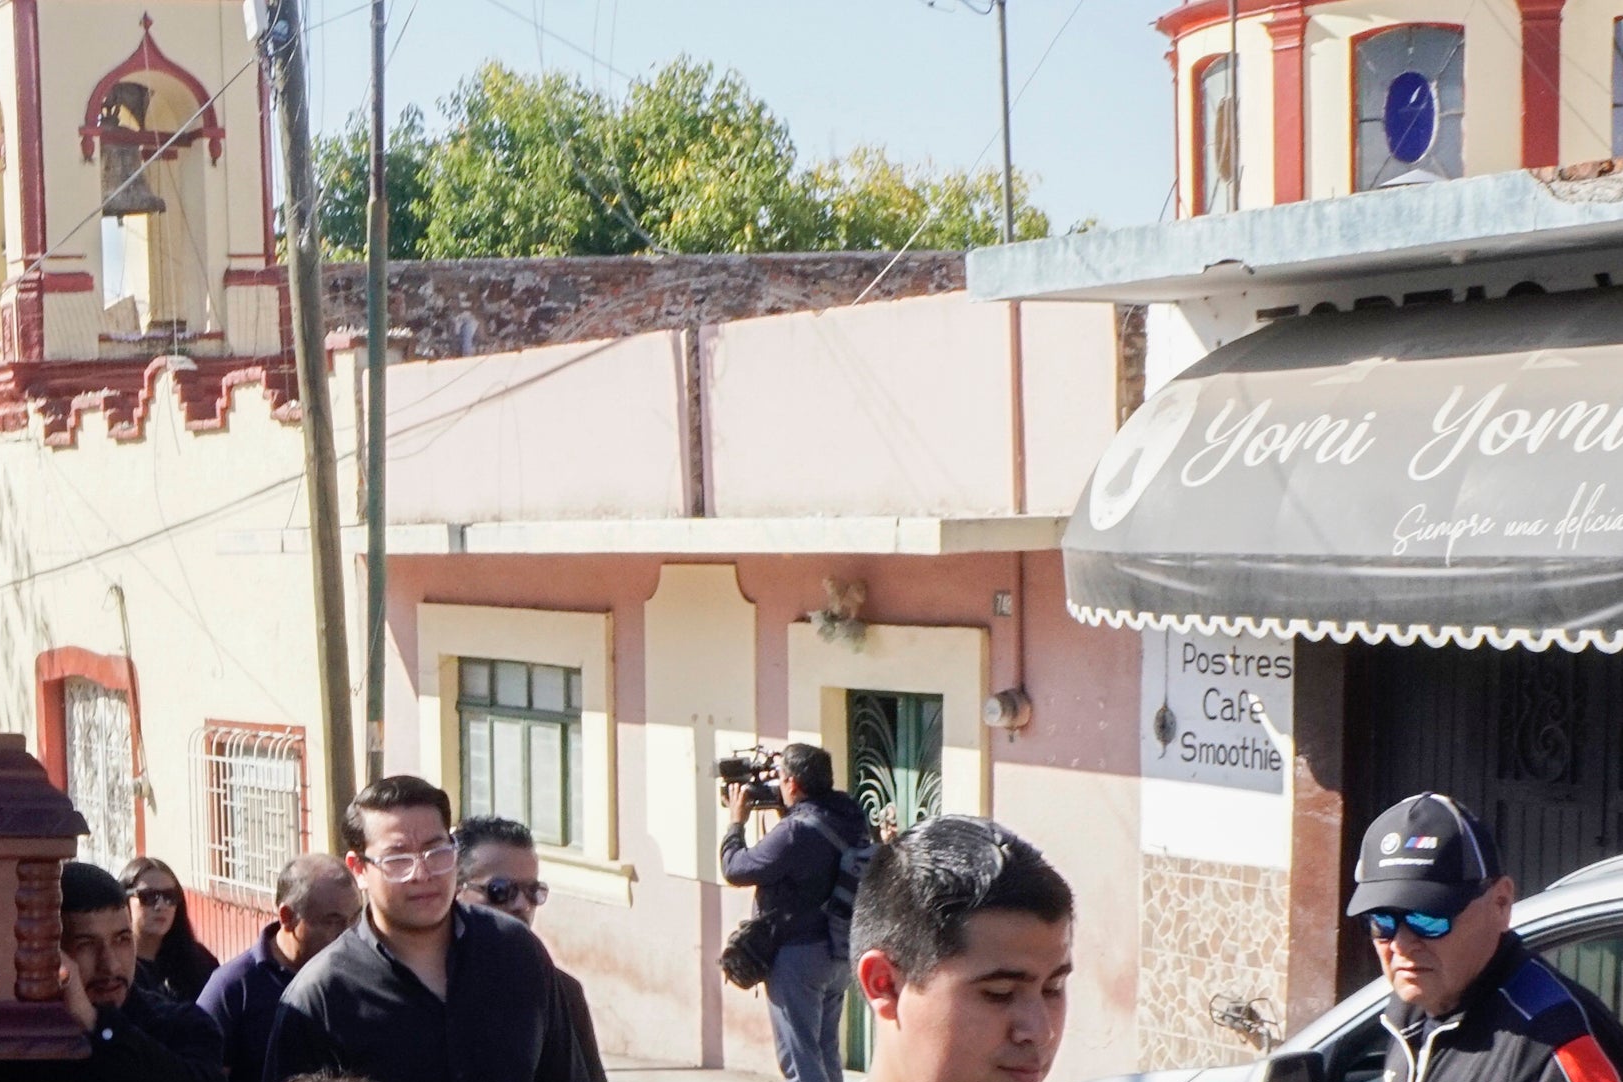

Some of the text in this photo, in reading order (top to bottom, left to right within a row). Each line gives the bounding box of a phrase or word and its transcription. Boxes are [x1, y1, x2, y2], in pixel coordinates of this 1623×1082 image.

[1181, 398, 1376, 487] Yomi
[1392, 503, 1496, 568] Siempre
[1504, 519, 1549, 537] una
[1182, 642, 1293, 679] Postres
[1180, 731, 1282, 771] Smoothie
